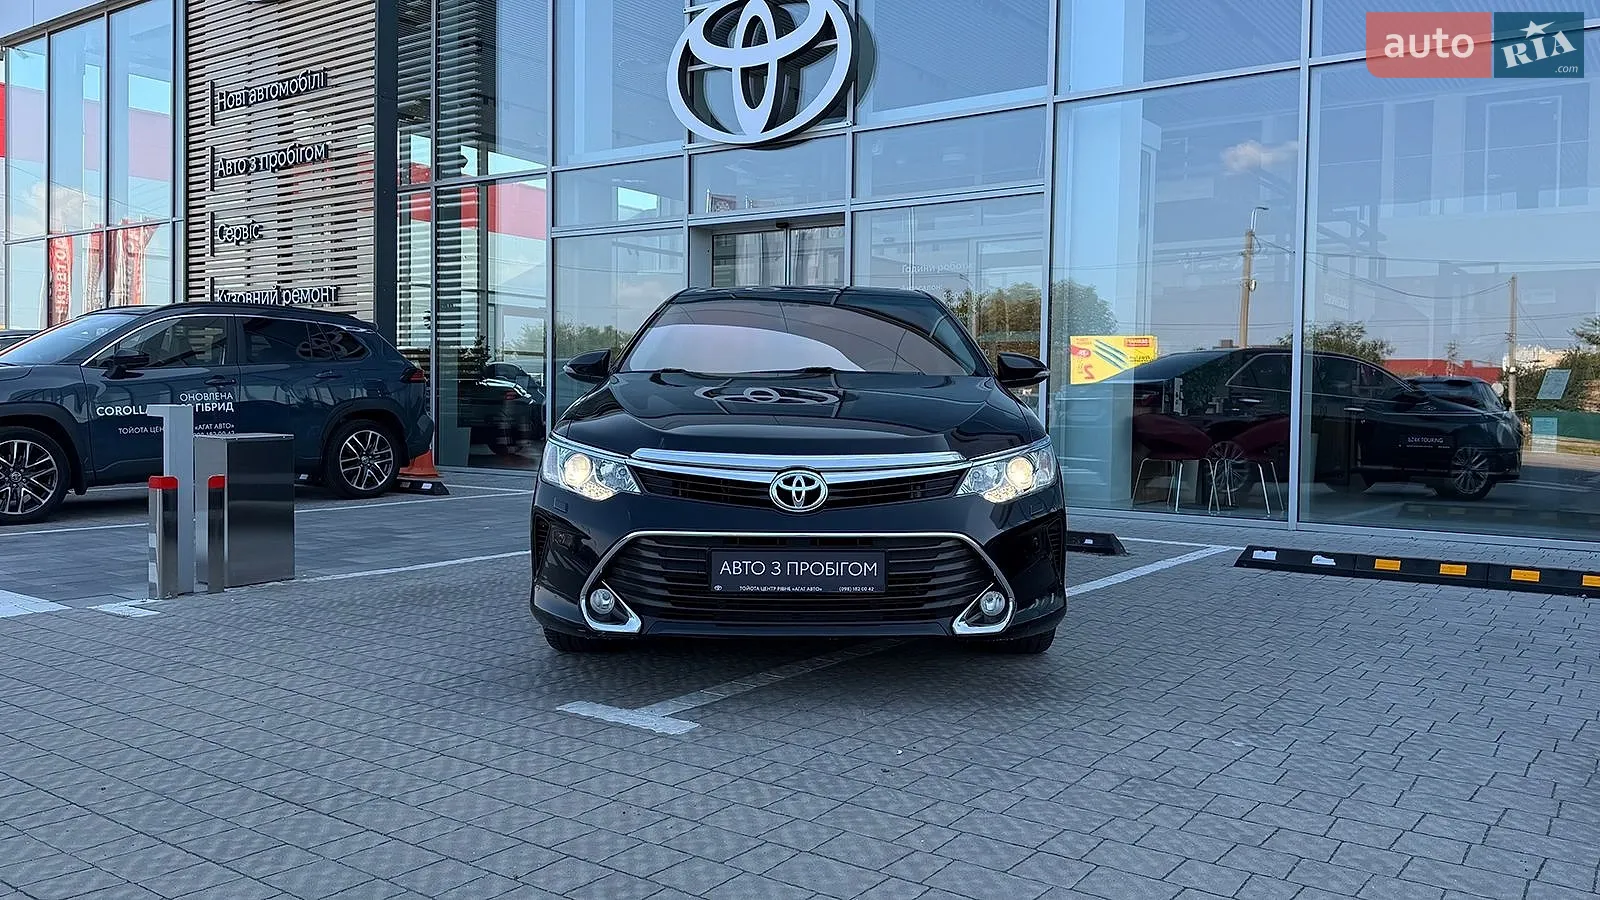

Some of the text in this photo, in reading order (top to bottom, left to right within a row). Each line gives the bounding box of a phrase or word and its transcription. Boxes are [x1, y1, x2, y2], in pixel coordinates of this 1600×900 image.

[217, 67, 327, 111] Нові автомобілі
[217, 143, 326, 177] Авто з пробігом
[217, 222, 261, 242] Сервіс
[283, 286, 337, 304] ремонт
[179, 391, 234, 402] ОНОВЛЕНА
[96, 405, 148, 416] COROLL
[195, 402, 235, 413] ГІБРИД
[118, 425, 149, 435] ТОЙОТА
[719, 561, 878, 577] АВТО З ПРОБІГОМ
